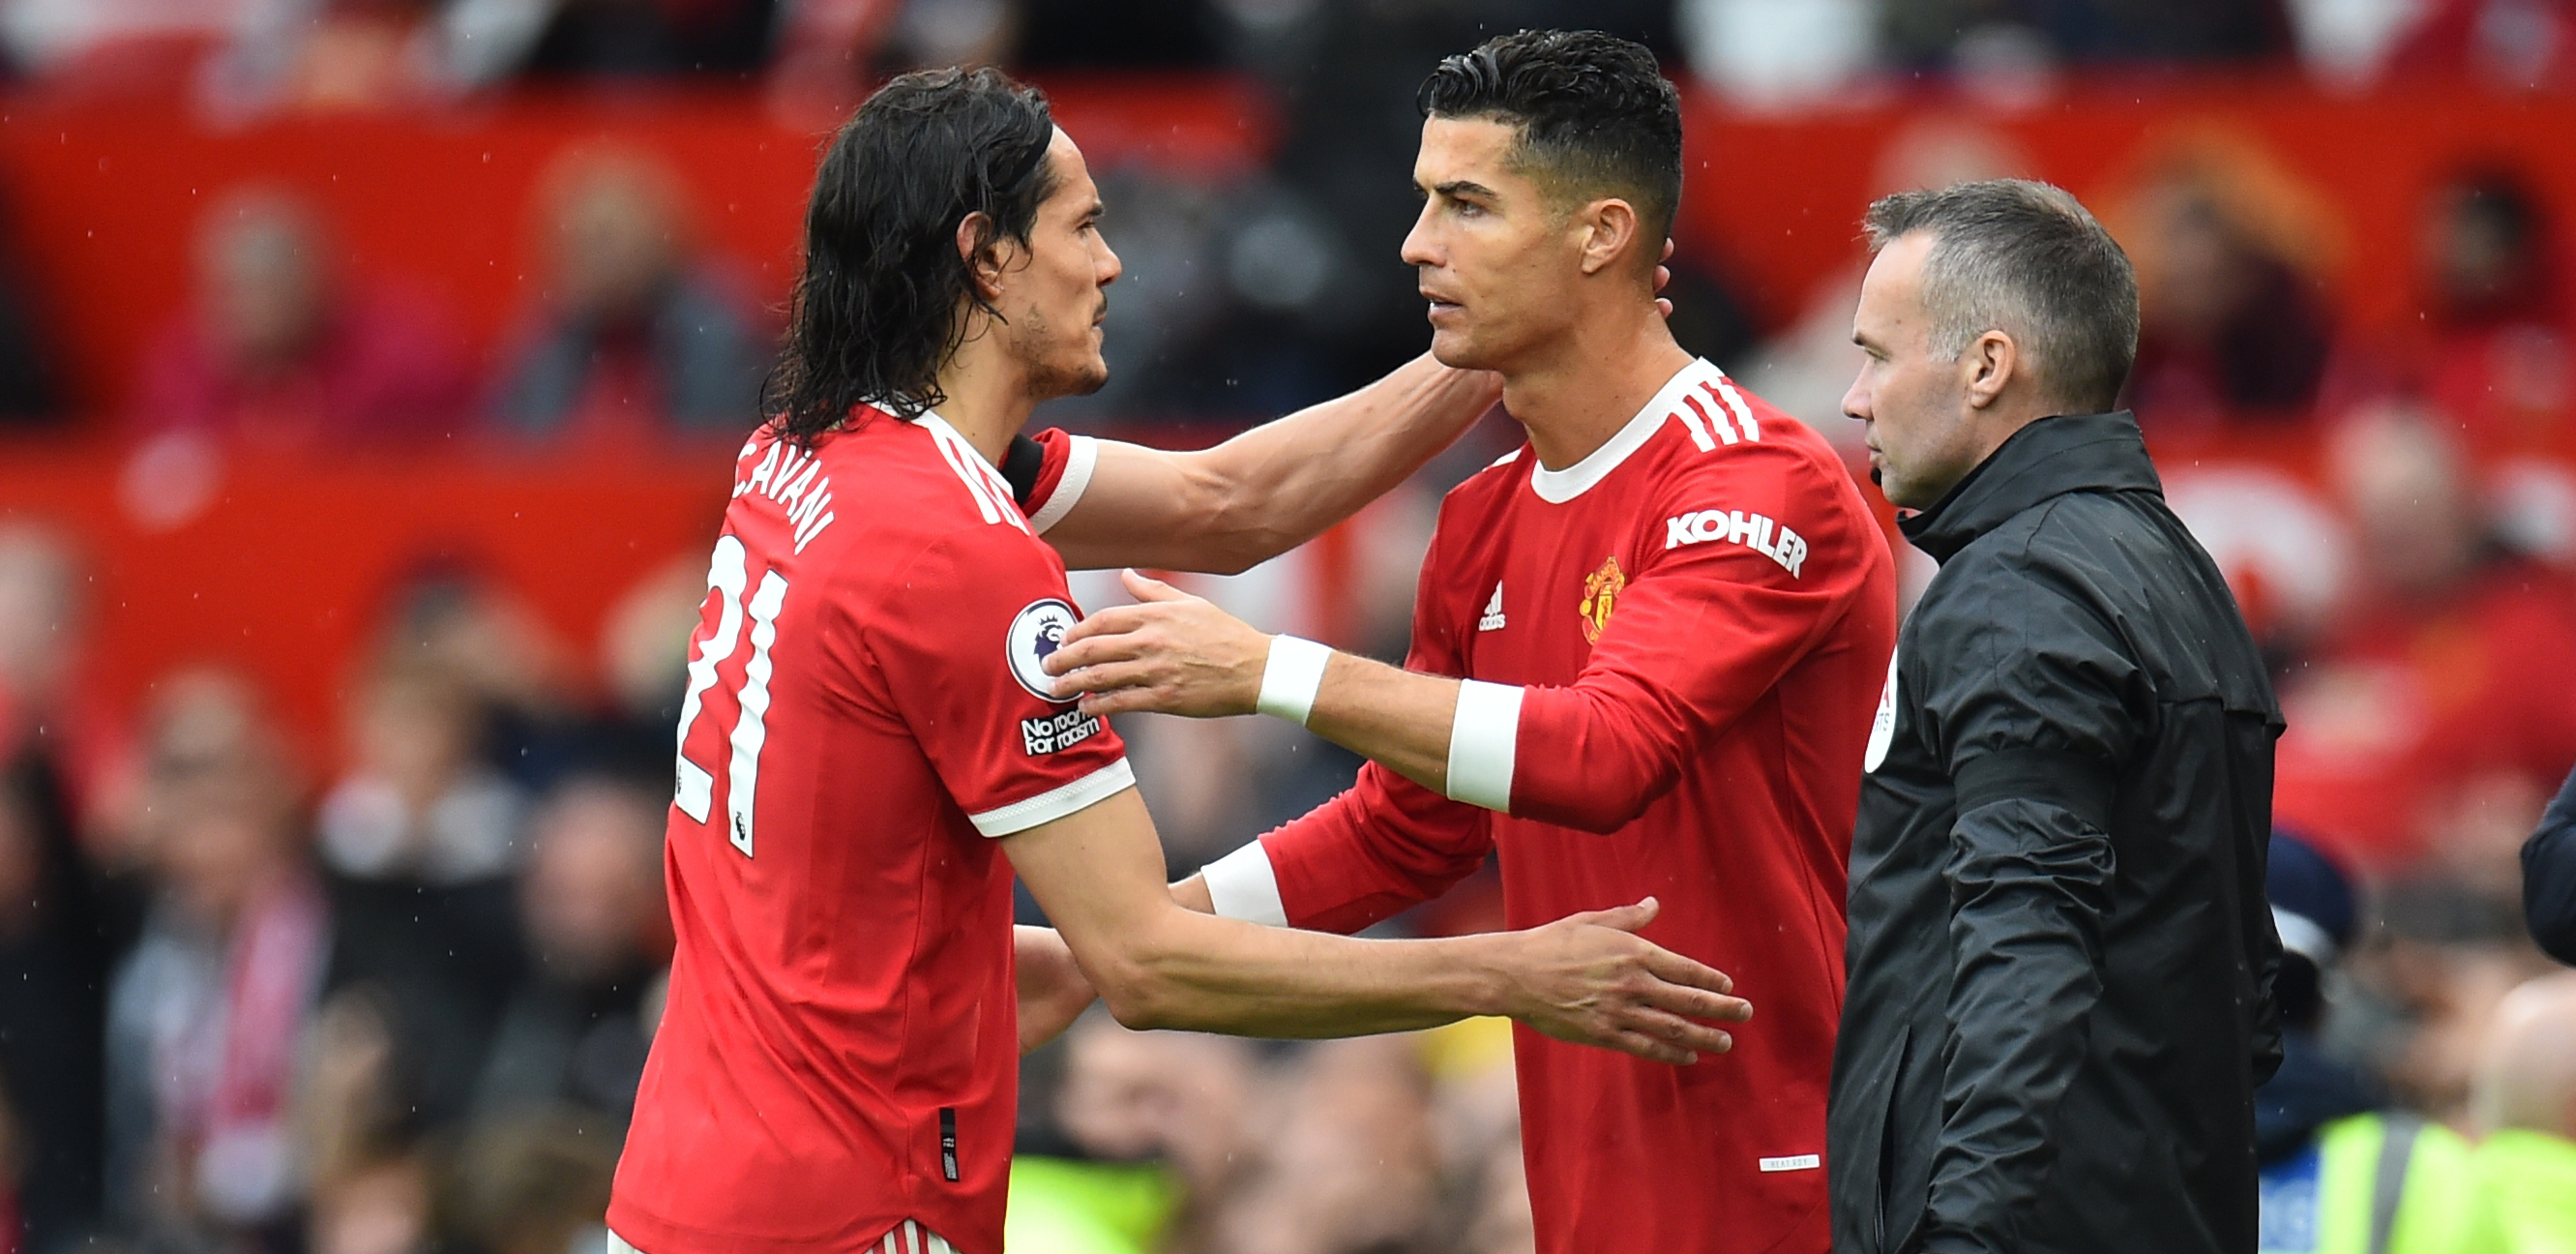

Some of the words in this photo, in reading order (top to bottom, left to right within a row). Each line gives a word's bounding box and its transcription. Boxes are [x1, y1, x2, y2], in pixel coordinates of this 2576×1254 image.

[732, 439, 835, 556] CAVANI
[1665, 509, 1808, 581] KOHLER
[674, 534, 788, 858] 21
[1022, 719, 1053, 738] No
[1025, 736, 1054, 756] For
[1056, 717, 1100, 750] racism
